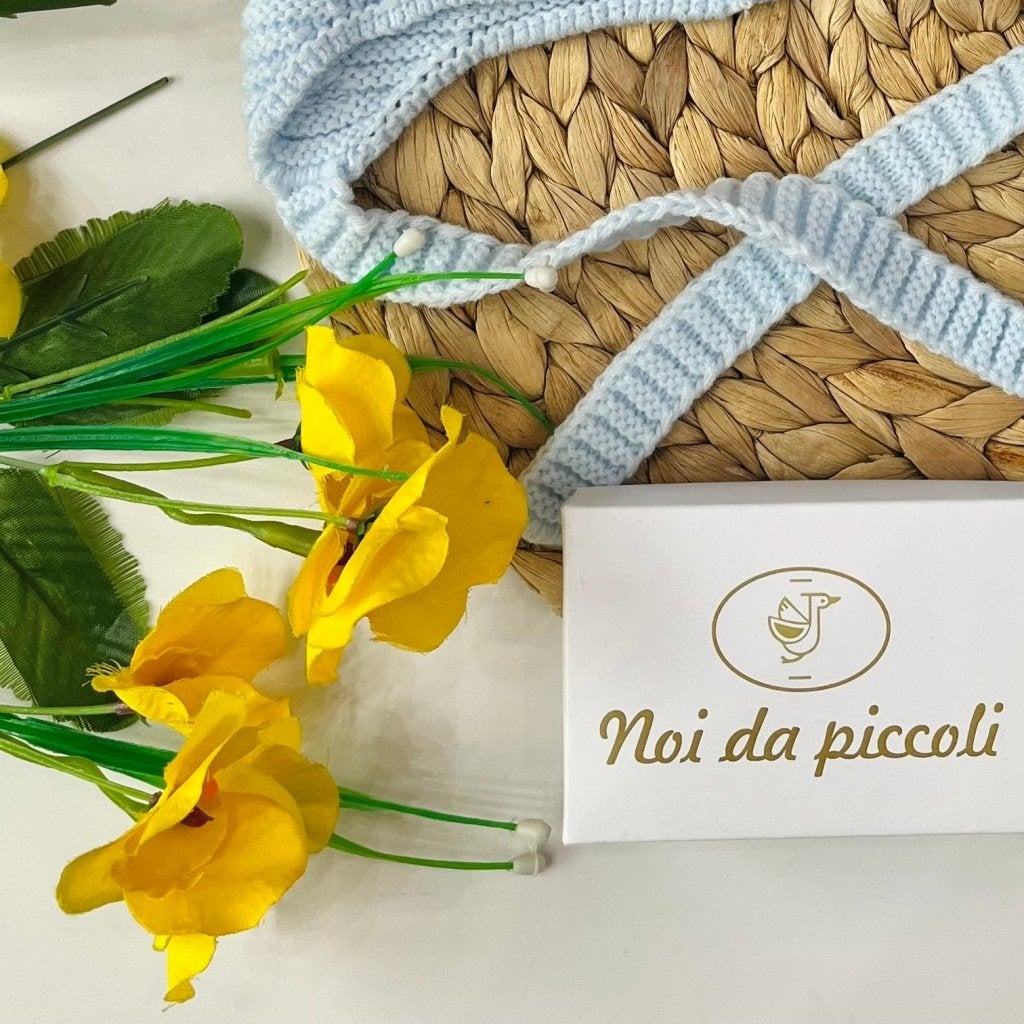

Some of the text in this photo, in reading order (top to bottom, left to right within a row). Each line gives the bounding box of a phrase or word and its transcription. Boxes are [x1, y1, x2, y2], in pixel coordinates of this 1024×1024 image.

[599, 702, 1004, 778] Noi da piccoli
